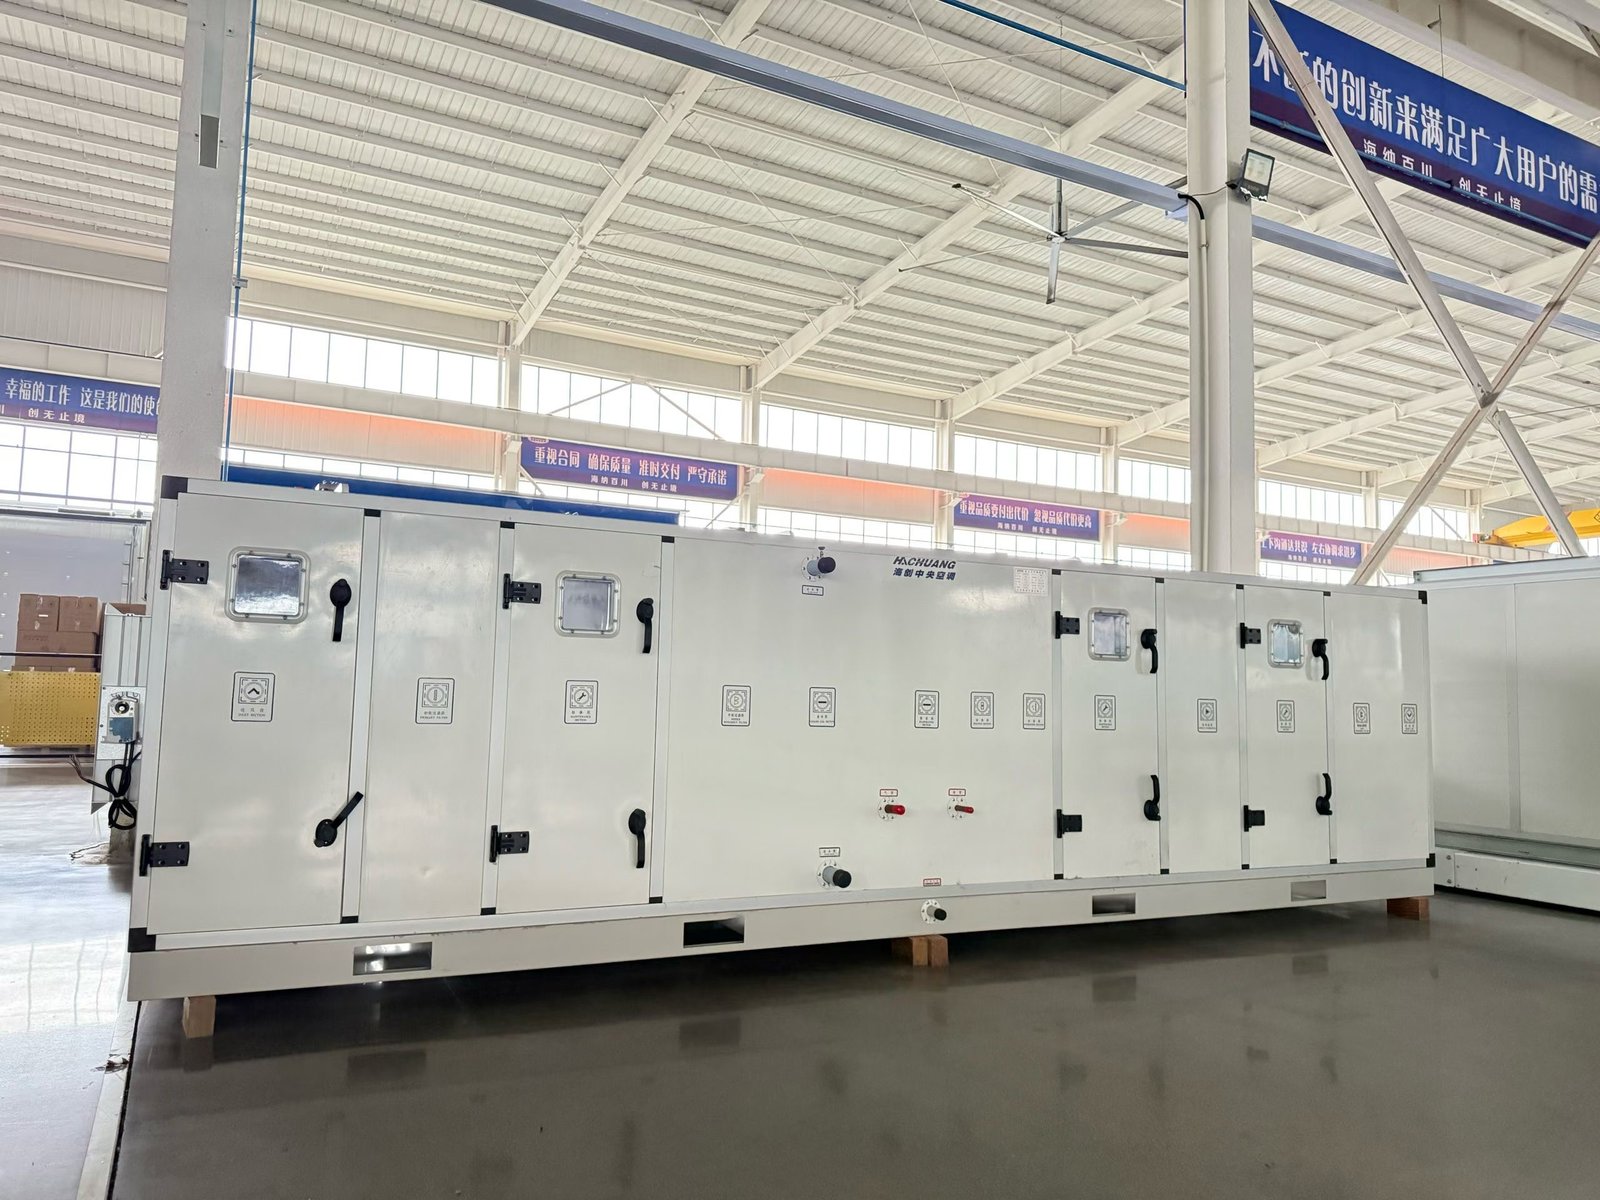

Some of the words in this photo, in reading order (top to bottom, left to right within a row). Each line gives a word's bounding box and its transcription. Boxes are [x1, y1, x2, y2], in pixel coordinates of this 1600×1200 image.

[1363, 138, 1433, 179] 海纳百川
[5, 378, 71, 406] 幸福的工作
[28, 408, 85, 424] 创无止境
[534, 446, 580, 468] 重视合同
[588, 453, 632, 475] 确保质量
[639, 459, 680, 481] 准时交付
[687, 465, 727, 486] 严守承诺
